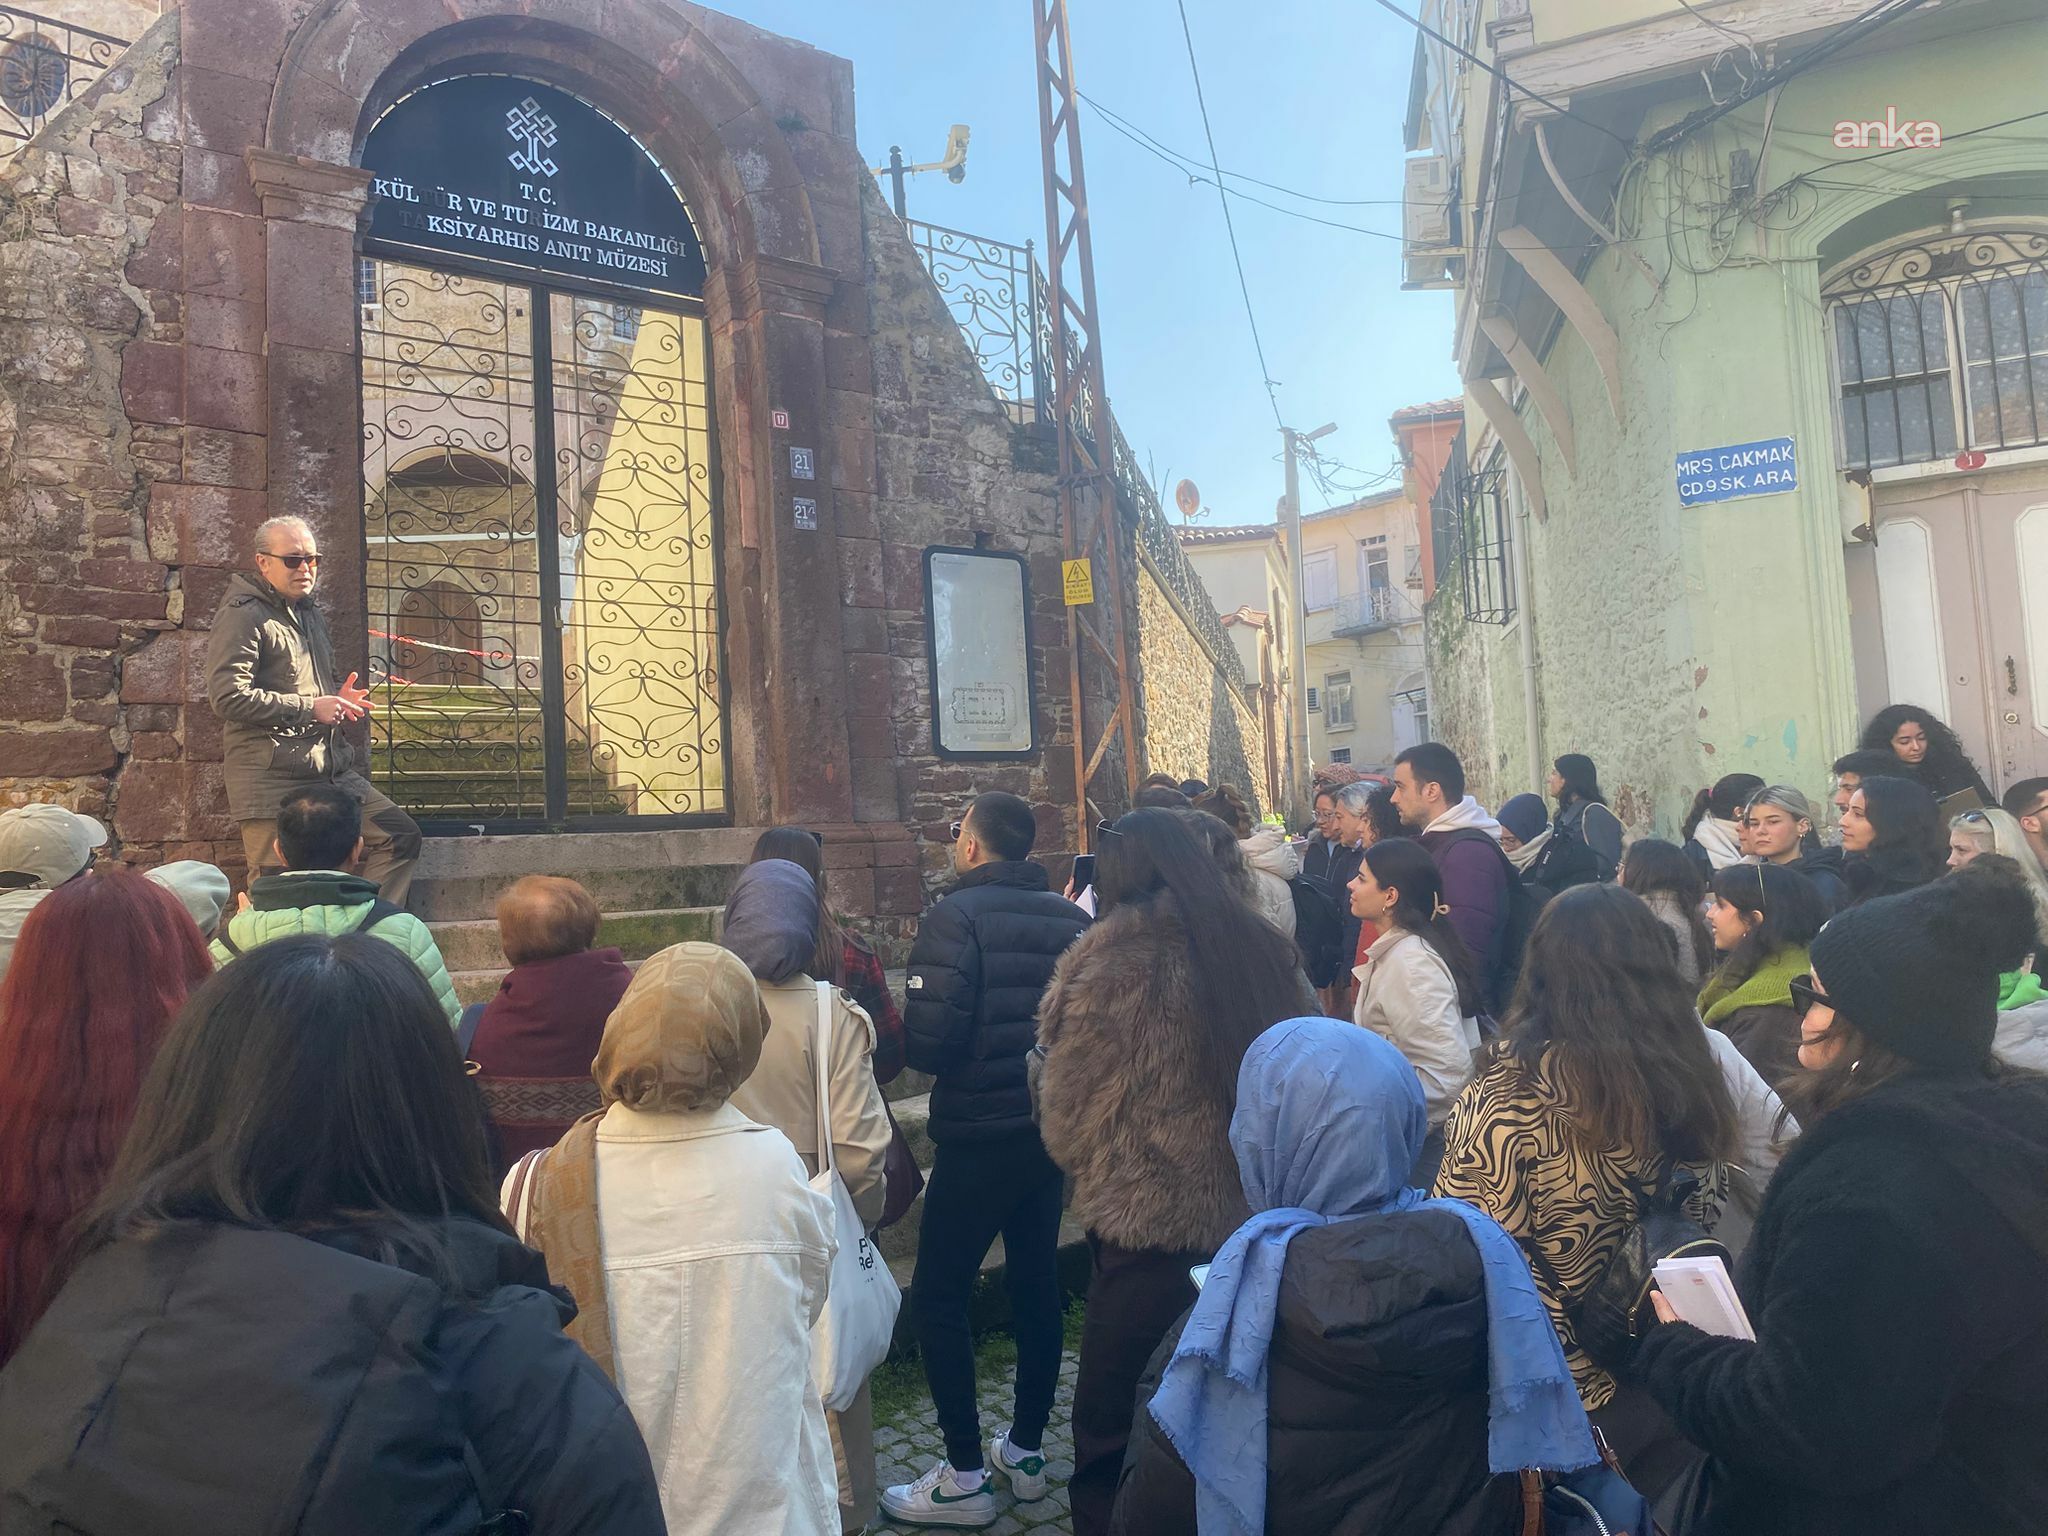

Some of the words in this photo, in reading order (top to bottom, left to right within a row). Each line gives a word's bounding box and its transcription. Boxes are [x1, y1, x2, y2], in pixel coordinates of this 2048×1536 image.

[519, 182, 558, 206] T.C.
[467, 196, 497, 219] VE
[583, 221, 687, 258] BAKANLIĞI
[544, 238, 592, 263] ANIT
[596, 248, 669, 278] MÜZESİ
[777, 415, 785, 425] 17
[795, 454, 809, 470] 21
[1753, 469, 1794, 487] ARA
